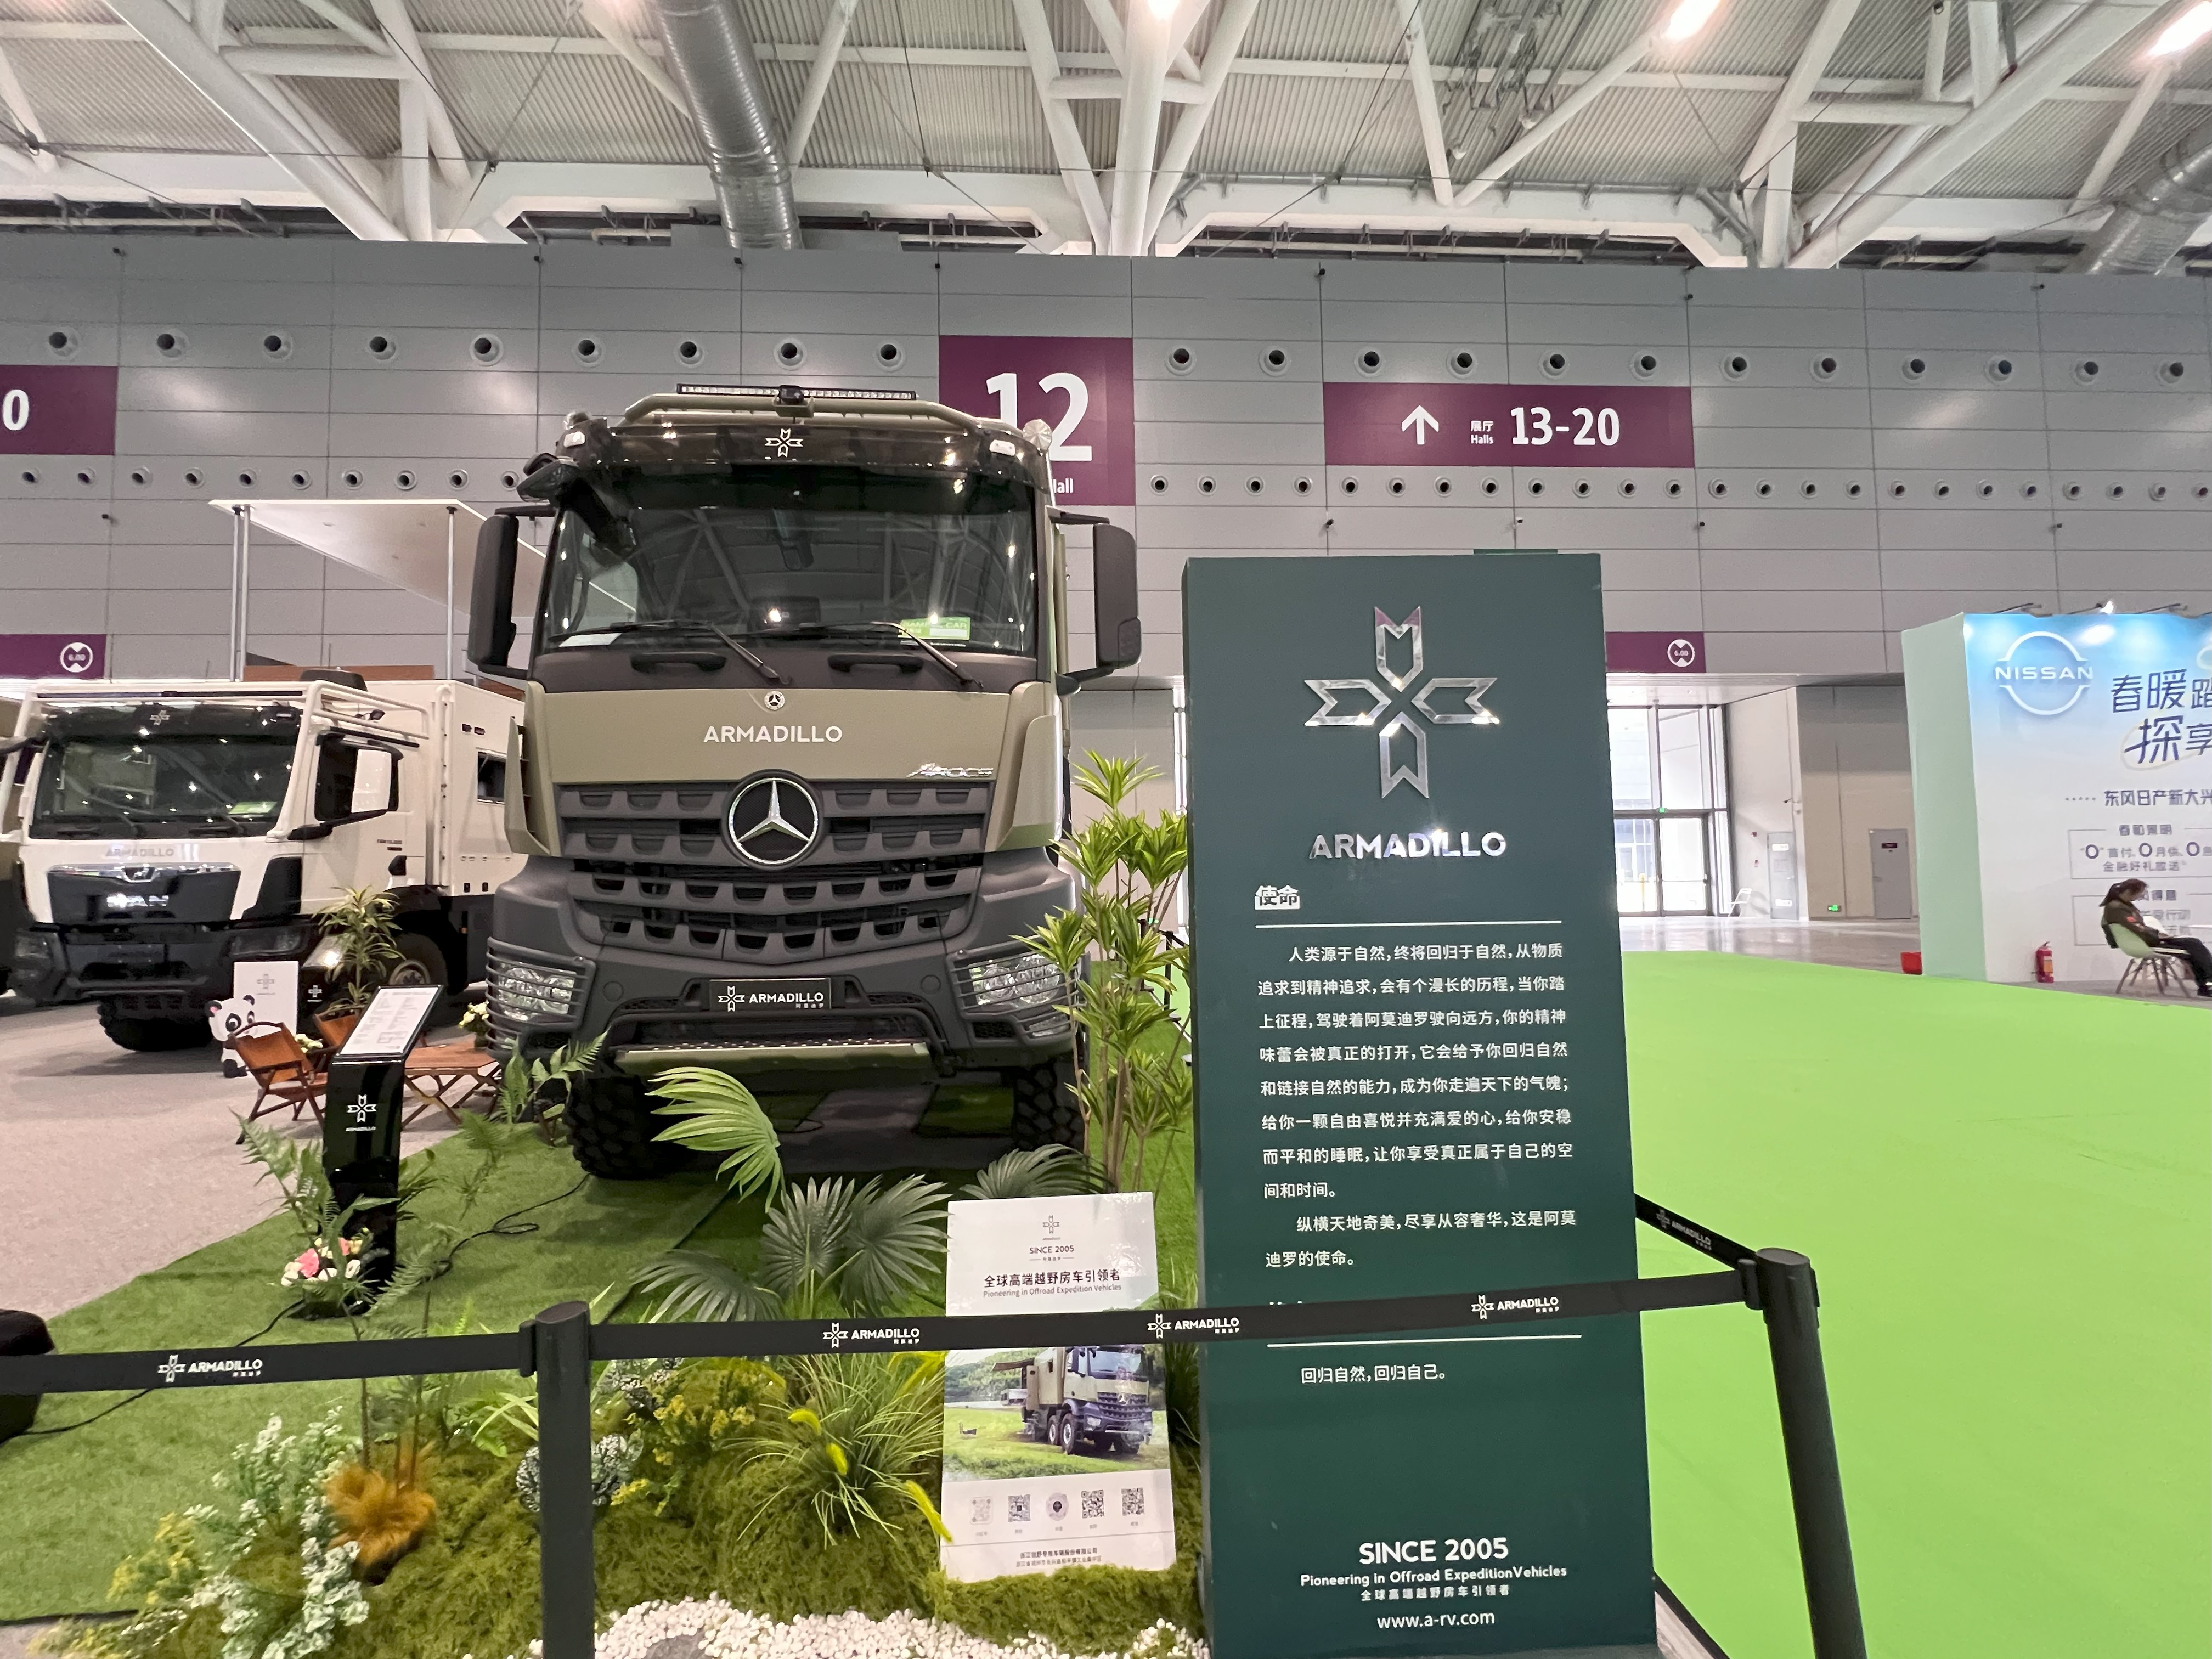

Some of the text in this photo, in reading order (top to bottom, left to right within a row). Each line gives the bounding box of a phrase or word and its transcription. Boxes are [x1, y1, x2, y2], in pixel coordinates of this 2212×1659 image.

[986, 372, 1092, 461] 12
[1471, 420, 1493, 432] 展厅
[1510, 407, 1620, 446] 13-20
[1471, 434, 1494, 444] Halls
[1995, 666, 2094, 680] NISSAN
[703, 725, 843, 743] ARMADILLO
[1309, 832, 1506, 859] ARMADILLO
[1255, 885, 1299, 909] 使命
[1289, 943, 1562, 962] 人类源于自然，终将回归于自然，从物质
[1257, 975, 1564, 996] 追求到精神追求，会有个漫长的历程，当你踏
[749, 992, 824, 1003] ARMADILLO
[1260, 1042, 1568, 1063] 味蕾会被真正的打开，它会给予你回归自然
[1262, 1109, 1571, 1130] 给你一颗自由喜悦并充满爱的心，给你安稳
[1263, 1142, 1573, 1165] 而平和的睡眠，让你享受真正属于自己的空
[1264, 1182, 1336, 1199] 间和时间。
[1296, 1210, 1576, 1232] 纵横天地奇美，尽享从容奢华，这是阿莫
[1029, 1245, 1075, 1254] SINCE 2005
[1266, 1250, 1355, 1267] 迪罗的使命。
[984, 1268, 1120, 1288] 全球高端越野房车引领者
[1057, 1286, 1093, 1295] Expedition
[1497, 1296, 1559, 1311] ARMADILLO
[1174, 1317, 1240, 1330] ARMADILLO
[851, 1328, 920, 1340] ARMADILLO
[187, 1359, 263, 1373] ARMADILLO
[1301, 1364, 1445, 1384] 回归自然，回归自己。
[1359, 1537, 1509, 1564] SINCE 2005
[1300, 1573, 1369, 1588] Pioneering
[1374, 1572, 1385, 1584] in
[1390, 1570, 1440, 1583] Offroad
[1361, 1584, 1510, 1601] 全球高端越野房车引领者
[1377, 1611, 1495, 1629] www.a-rv.com
